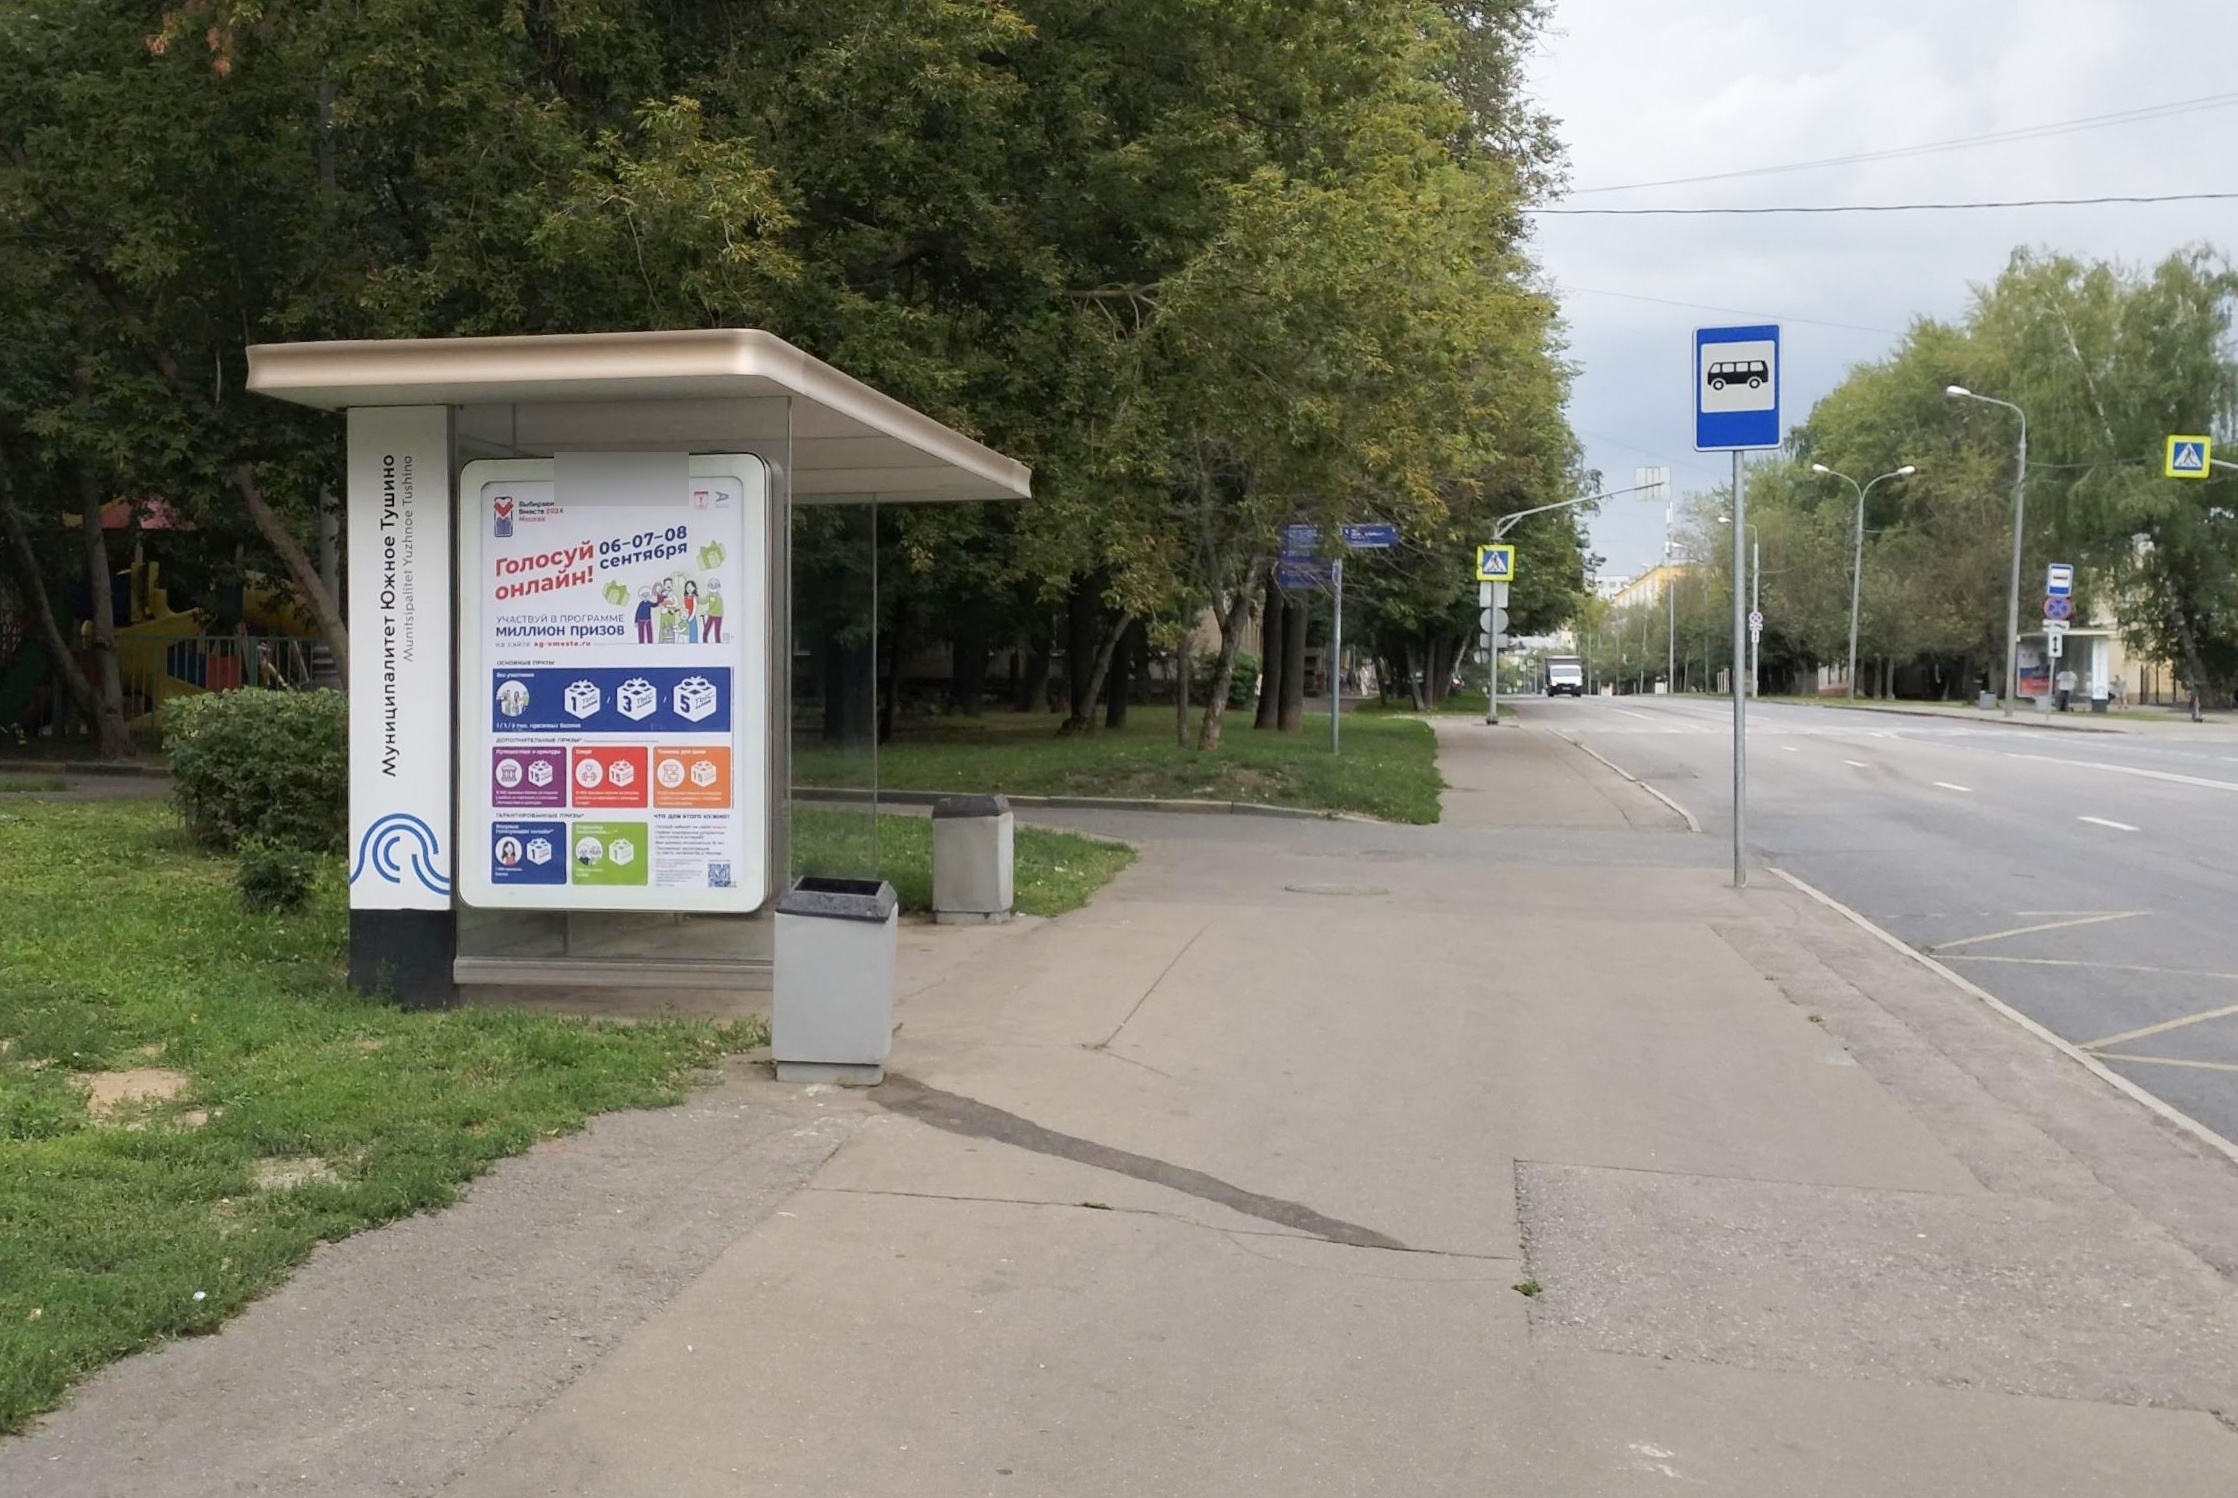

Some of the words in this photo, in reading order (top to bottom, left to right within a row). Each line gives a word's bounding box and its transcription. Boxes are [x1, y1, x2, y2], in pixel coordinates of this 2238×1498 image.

[380, 454, 399, 530] Тушино
[402, 455, 413, 507] Tushino
[402, 509, 415, 567] Yuzhnoe
[380, 536, 396, 609] Южное
[495, 541, 594, 576] Голосуй
[600, 542, 688, 570] сентября
[495, 566, 594, 601] онлайн!
[403, 569, 415, 663] Munitsipalitet
[496, 614, 547, 624] УЧАСТВУЙ
[560, 614, 624, 623] ПРОГРАММЕ
[381, 616, 399, 777] Муниципалитет
[571, 697, 577, 711] 1
[623, 695, 632, 713] 3
[680, 694, 691, 713] 5
